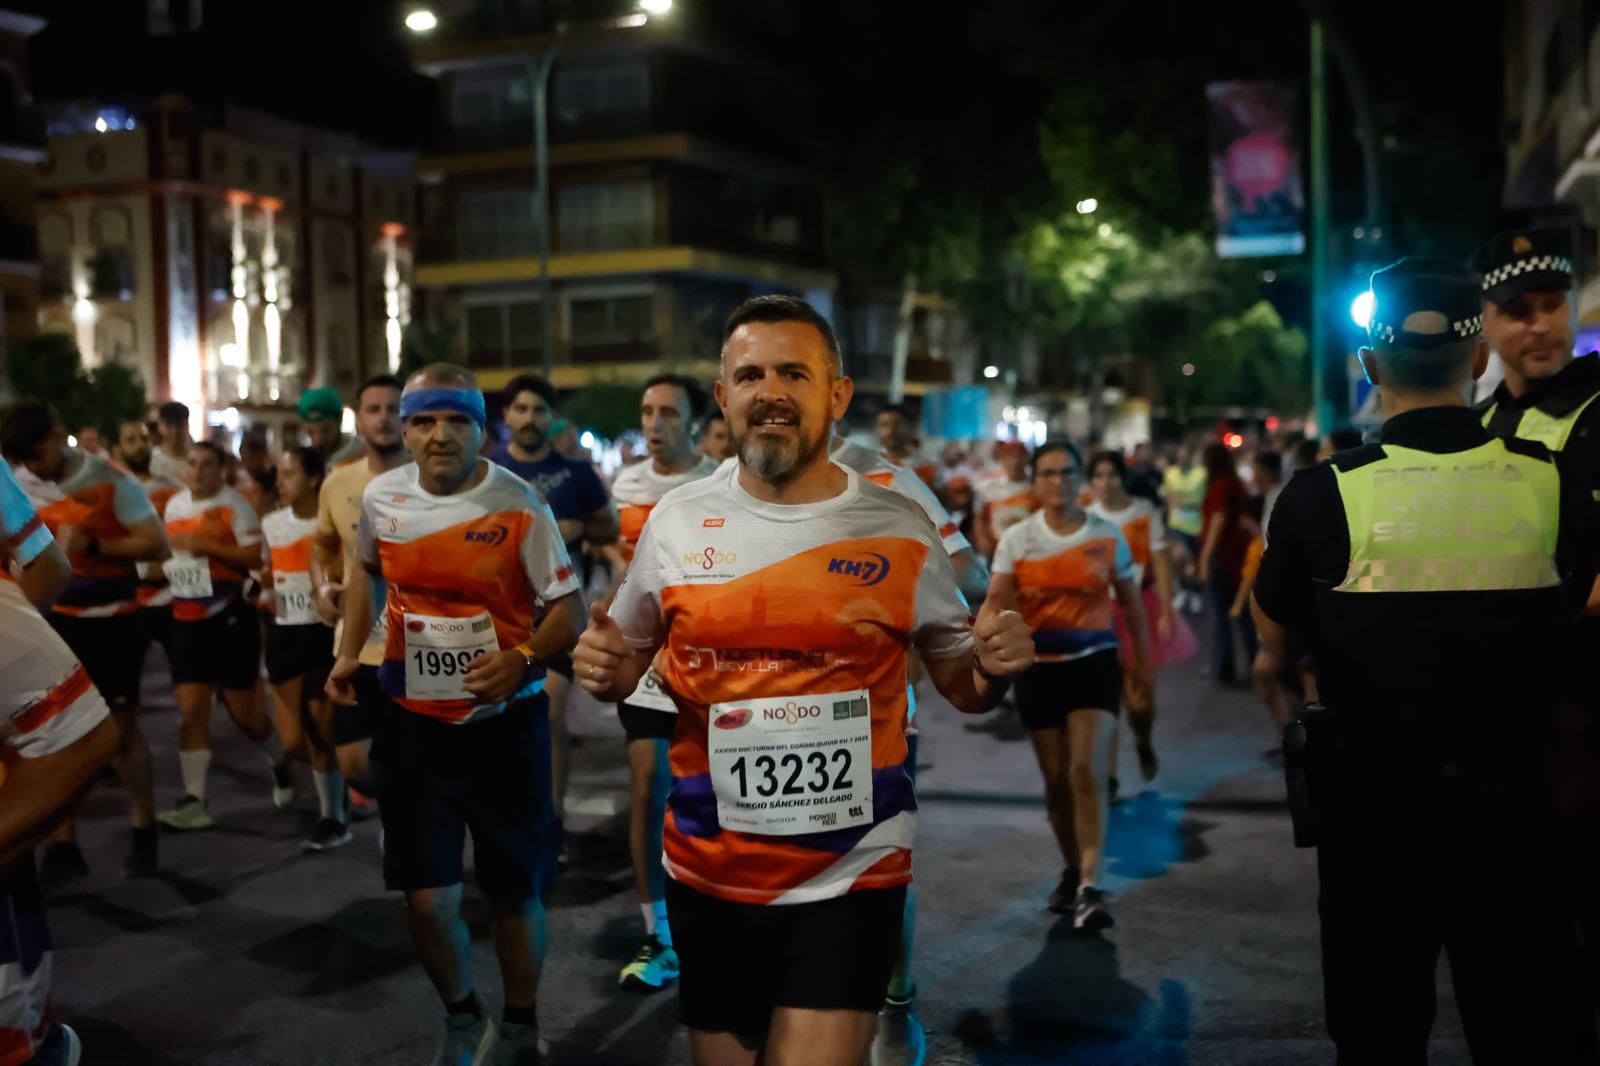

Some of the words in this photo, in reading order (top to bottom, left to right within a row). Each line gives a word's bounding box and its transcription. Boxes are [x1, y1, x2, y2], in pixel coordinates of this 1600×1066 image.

[1372, 519, 1532, 542] SEVILLA
[718, 662, 779, 672] SEVILLA
[738, 744, 776, 753] NOCTURNA
[776, 743, 788, 751] DEL
[730, 749, 854, 798] 13232
[735, 801, 768, 809] SERGIO
[769, 798, 811, 808] SÁNCHEZ
[812, 793, 853, 805] DELGADO
